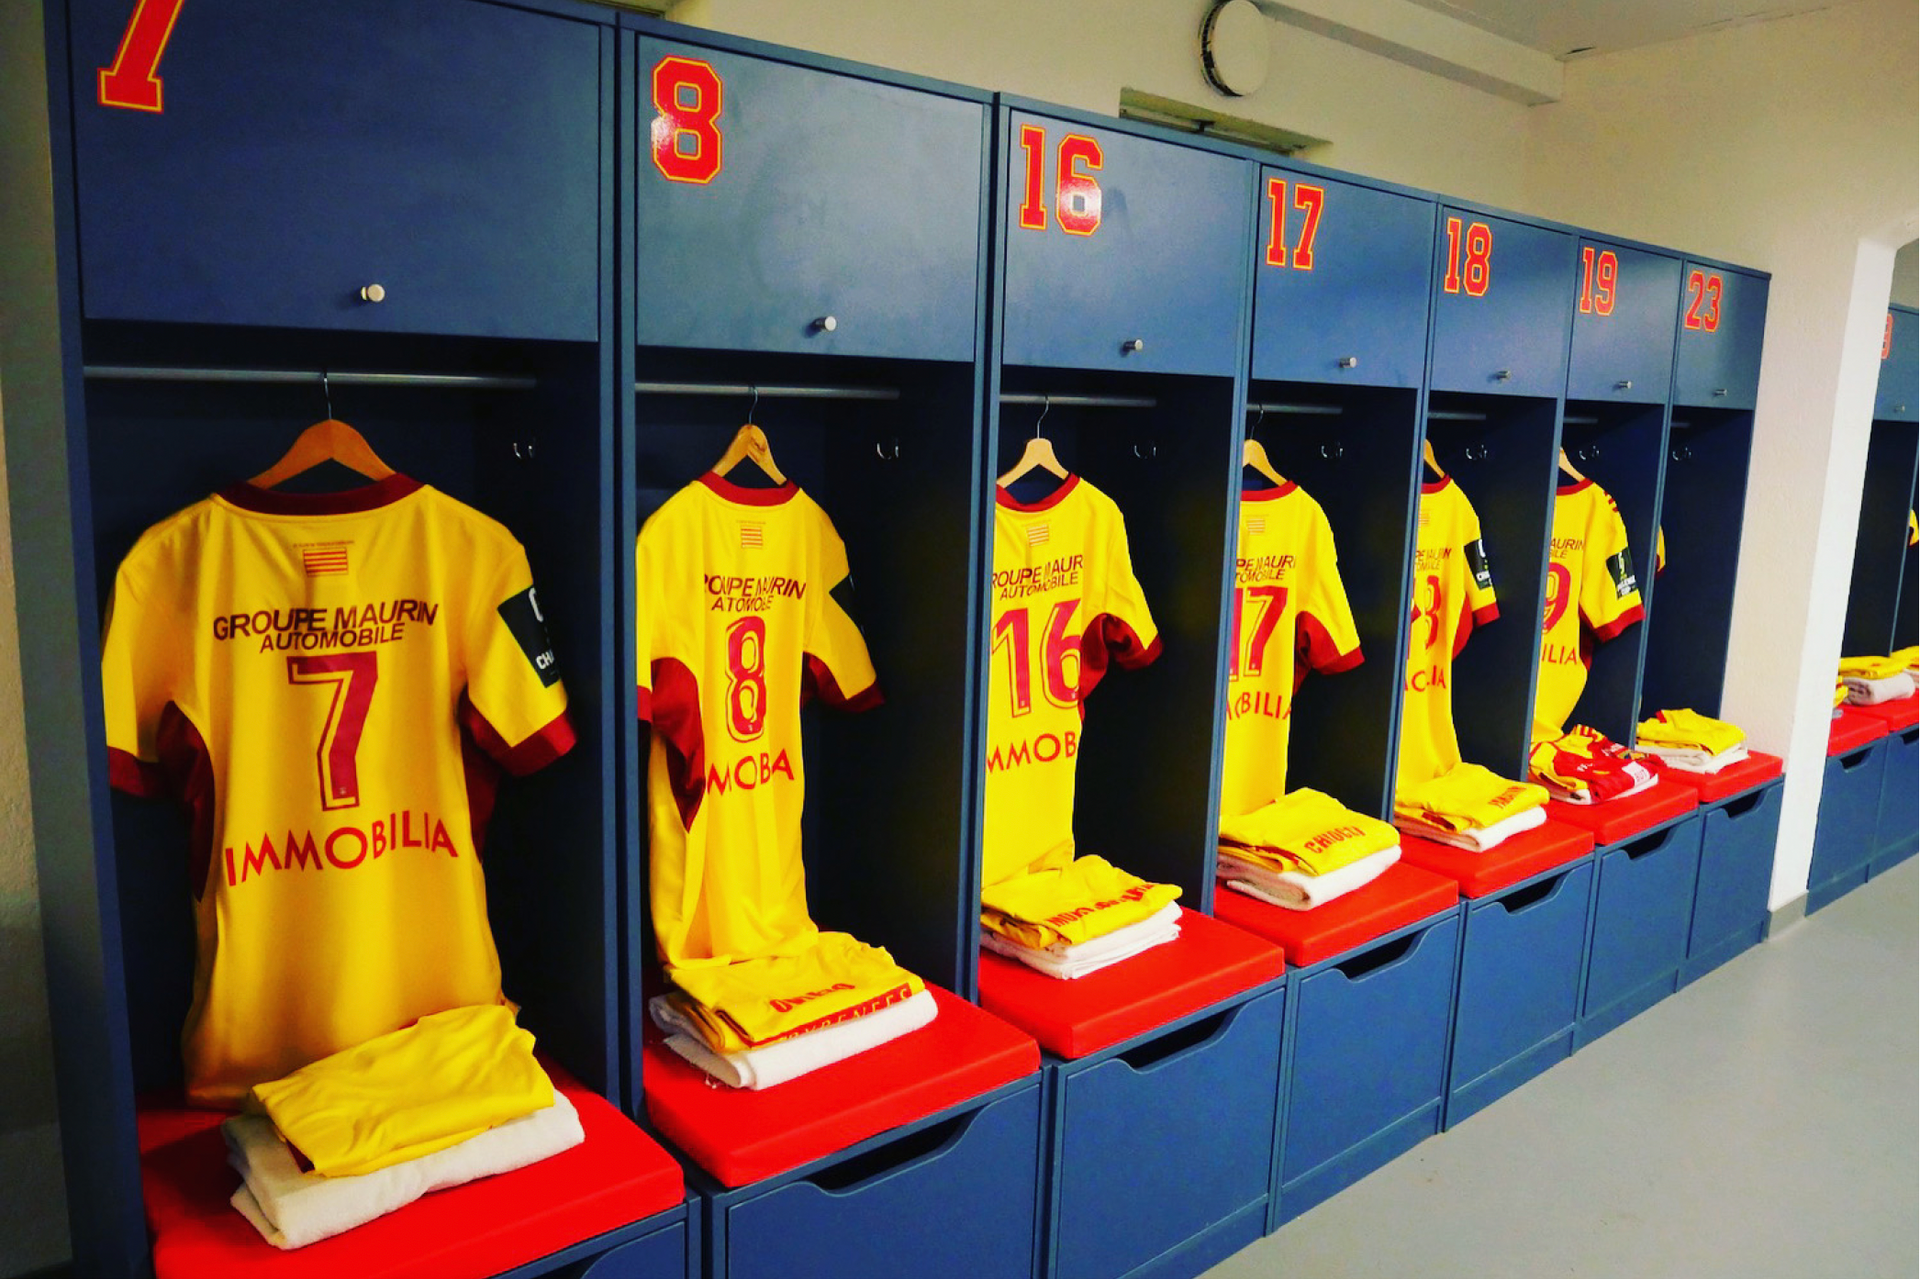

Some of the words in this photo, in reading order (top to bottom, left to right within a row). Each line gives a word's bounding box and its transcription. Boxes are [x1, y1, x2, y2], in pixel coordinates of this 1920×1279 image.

[651, 55, 724, 184] 8
[1019, 124, 1104, 236] 16
[1266, 177, 1325, 271] 17
[1443, 216, 1493, 297] 18
[1579, 246, 1619, 317] 19
[1683, 270, 1723, 333] 23
[213, 608, 327, 641] GROUPE
[334, 599, 438, 630] MAURIN
[260, 623, 405, 654] AUTOMOBILE
[991, 598, 1082, 719] 16
[725, 615, 767, 743] 8
[287, 651, 379, 812] 7
[225, 810, 459, 887] IMMOBILIA
